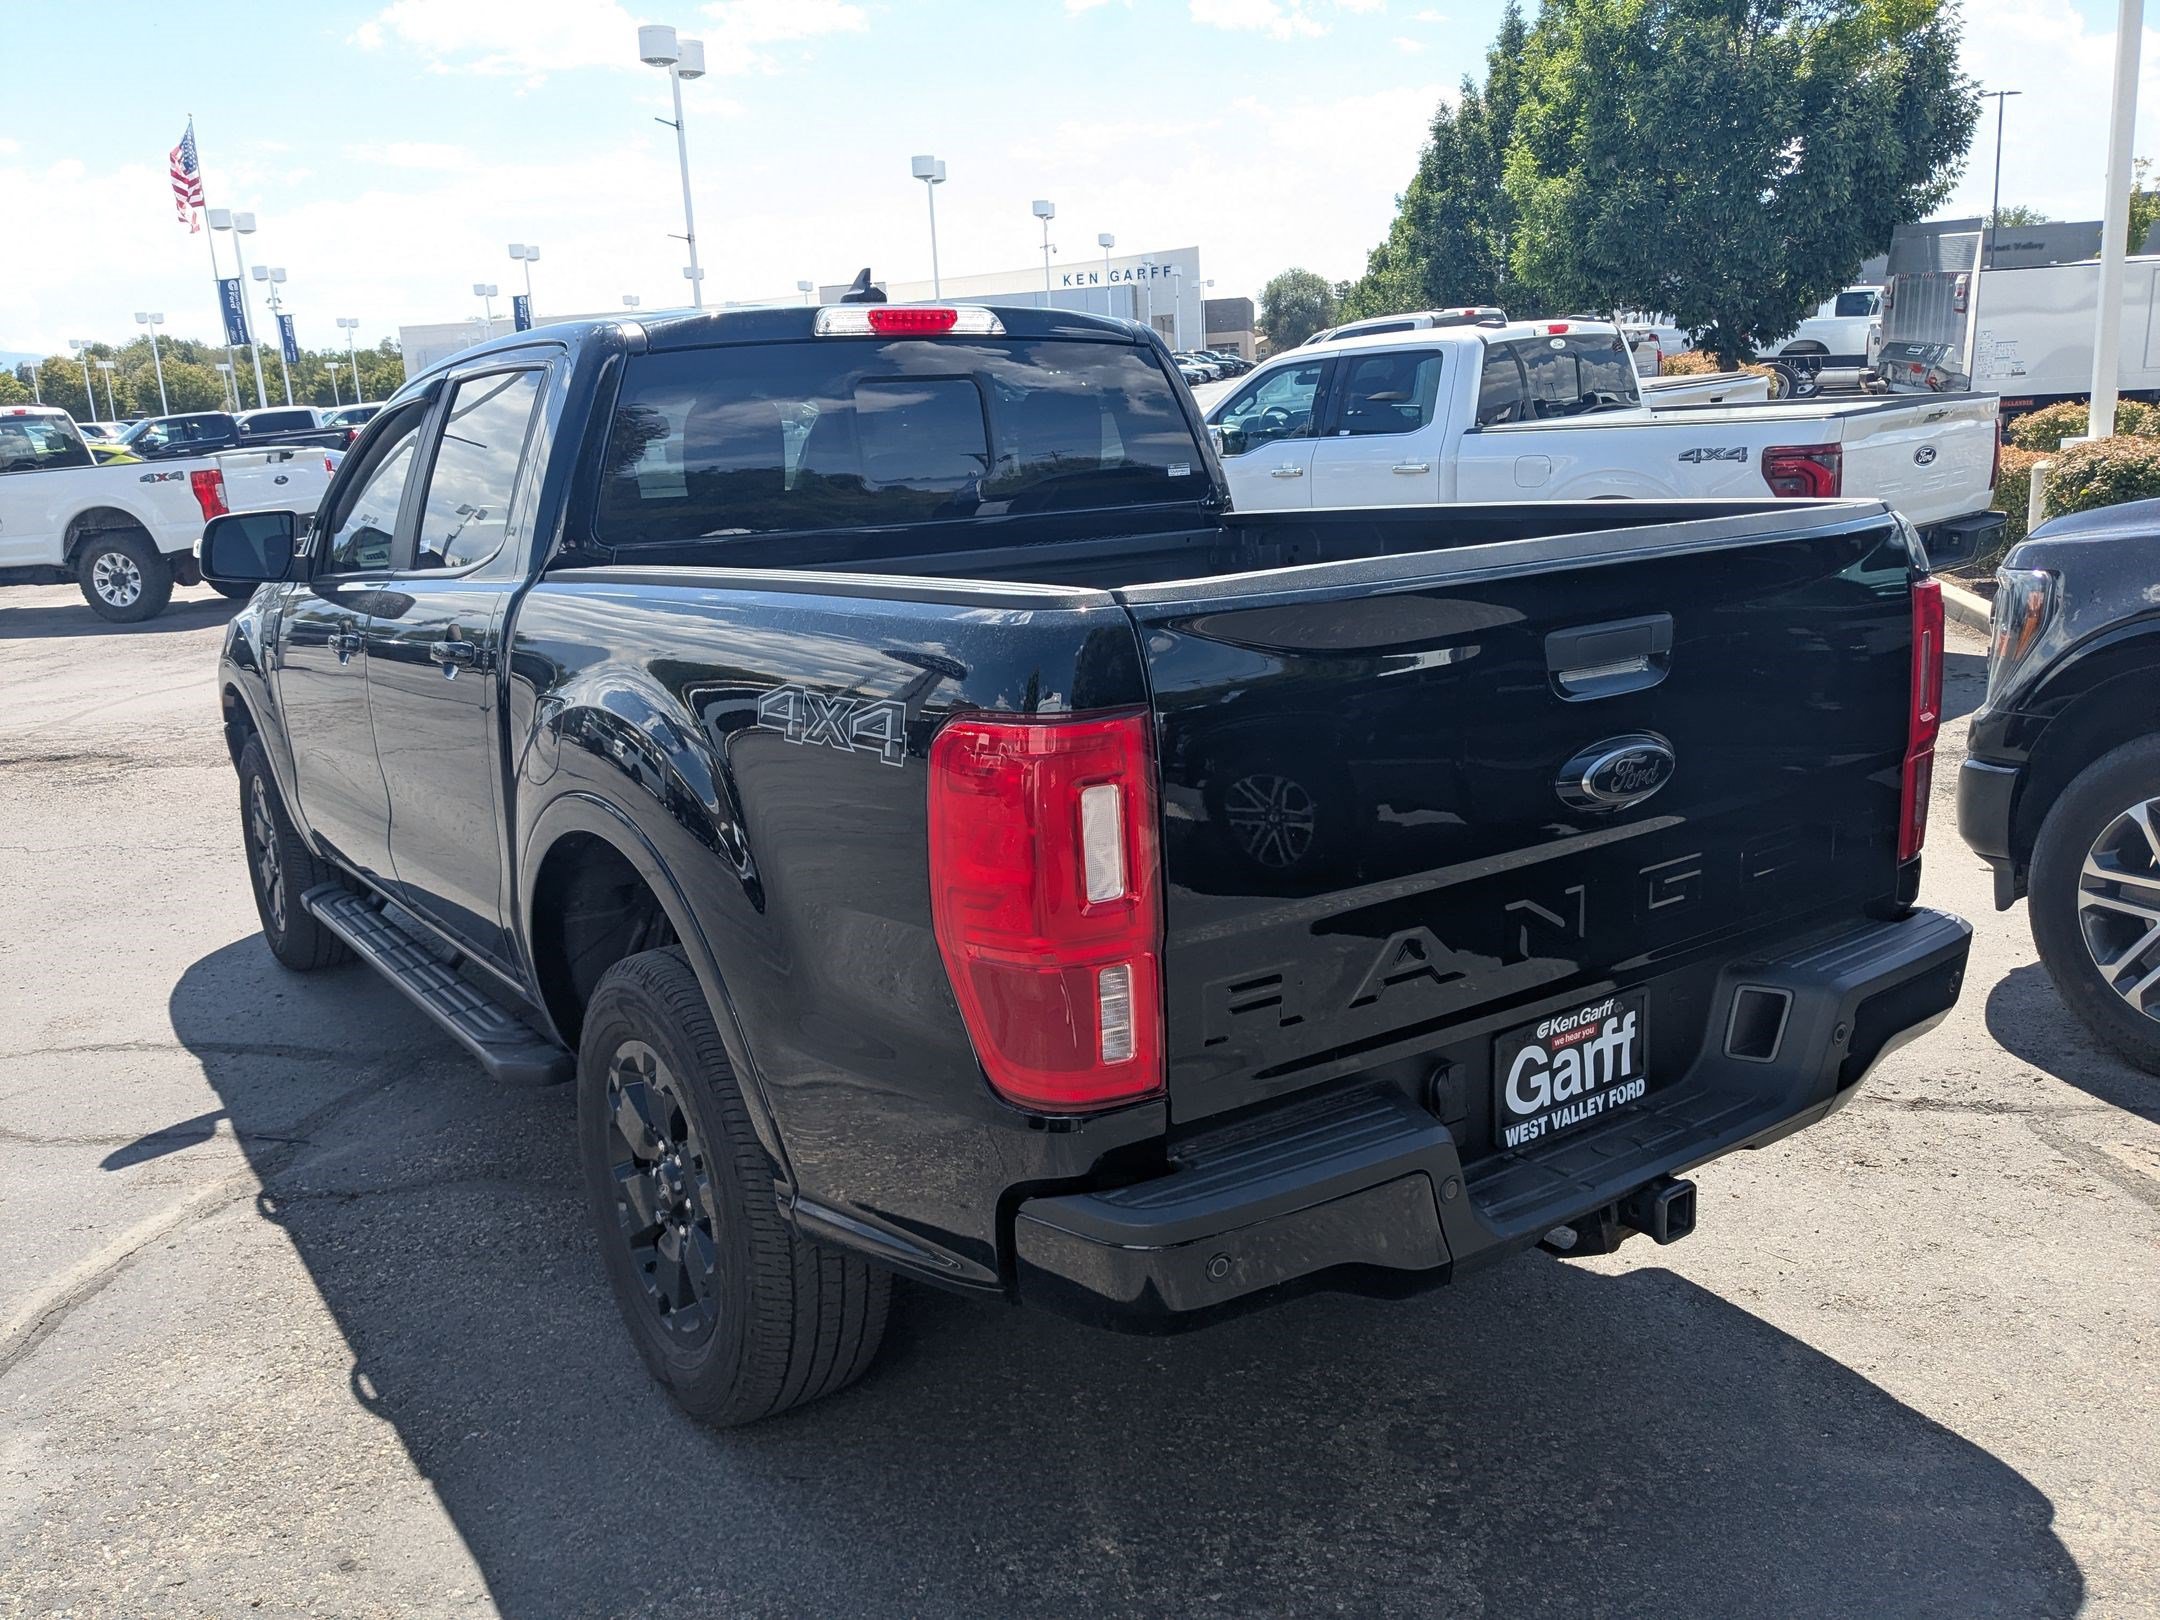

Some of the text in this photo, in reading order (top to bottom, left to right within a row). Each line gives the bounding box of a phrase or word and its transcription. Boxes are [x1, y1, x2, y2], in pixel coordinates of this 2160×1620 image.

[2013, 241, 2046, 251] Valley
[1063, 265, 1172, 286] KEN GARFF
[228, 291, 237, 309] Ford
[1918, 449, 1936, 463] Ford
[1610, 753, 1661, 793] Ford
[1549, 998, 1615, 1036] Ken Garff
[1553, 1026, 1595, 1047] we hear you
[1505, 1010, 1636, 1115] Garff
[1505, 1078, 1646, 1148] WEST VALLEY FORD
